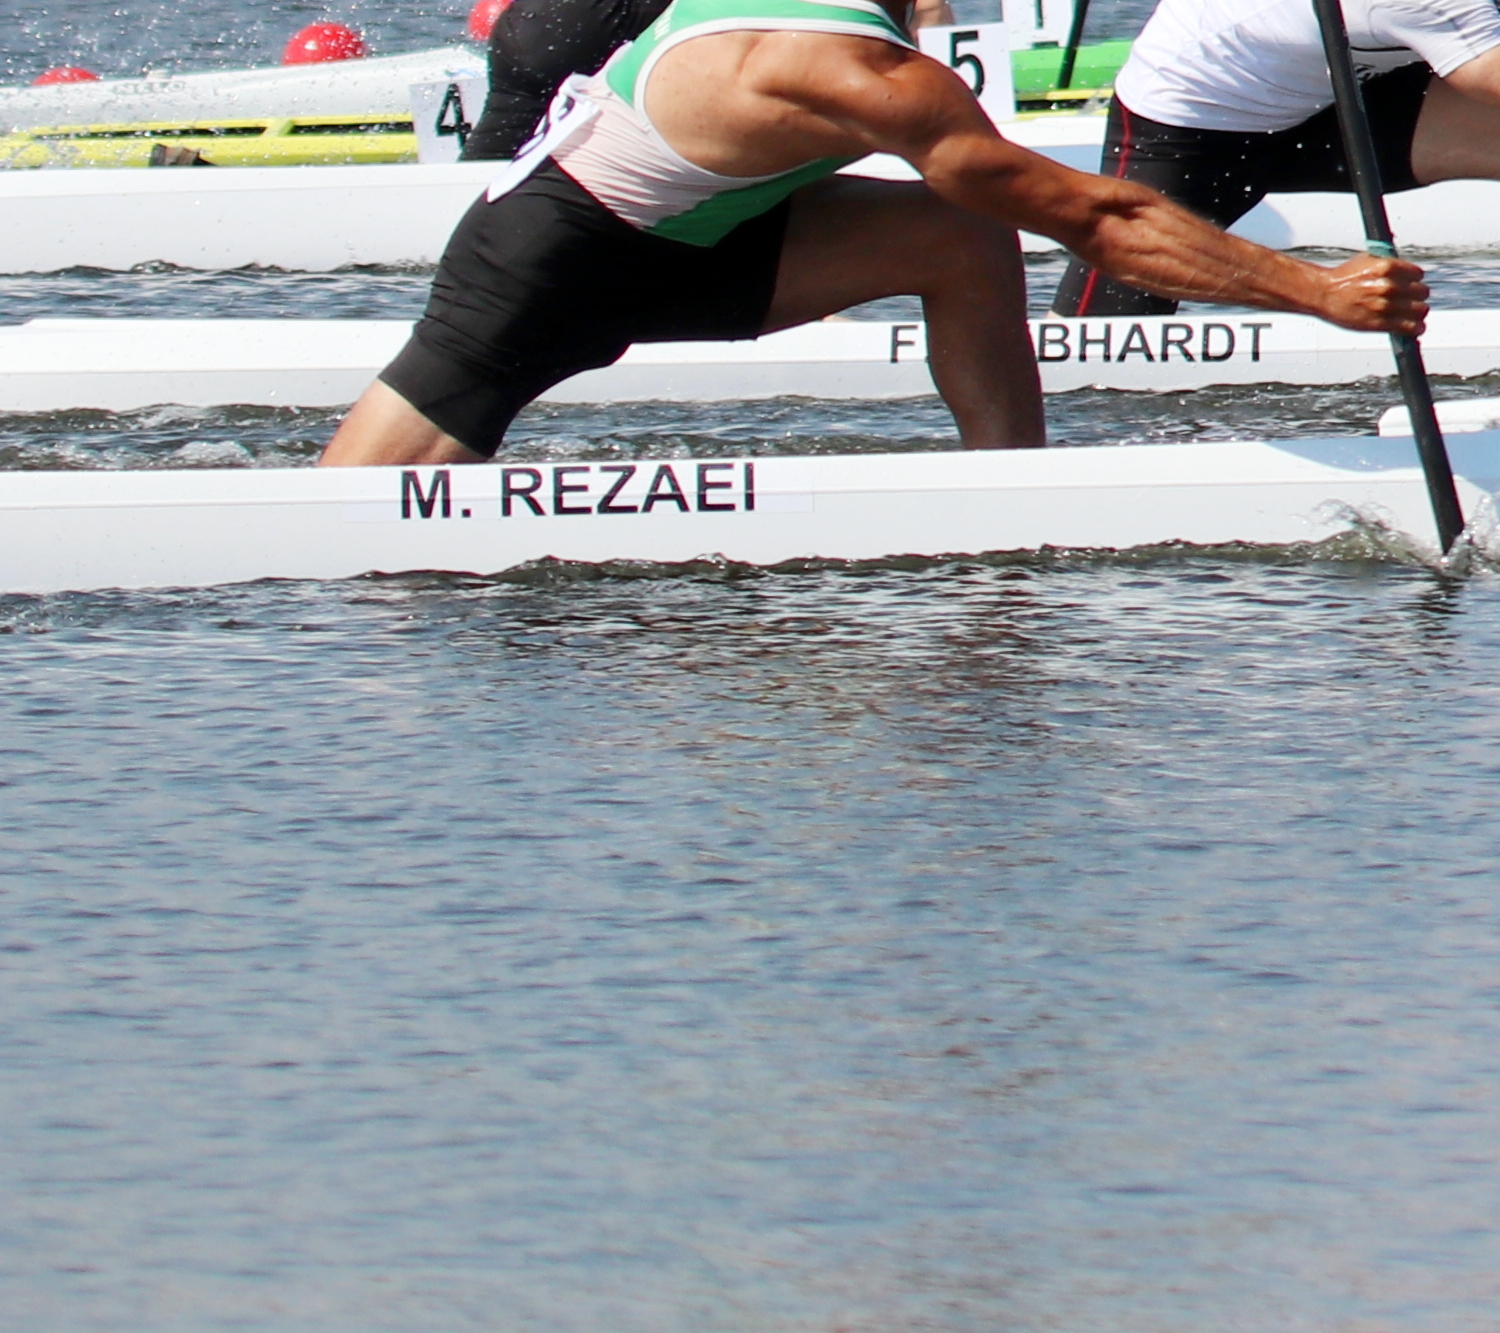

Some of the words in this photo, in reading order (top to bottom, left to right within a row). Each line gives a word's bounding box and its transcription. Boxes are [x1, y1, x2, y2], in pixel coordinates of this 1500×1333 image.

[950, 29, 986, 99] 5
[435, 82, 473, 155] 4
[400, 469, 472, 520] M.
[500, 462, 755, 518] REZAEI
